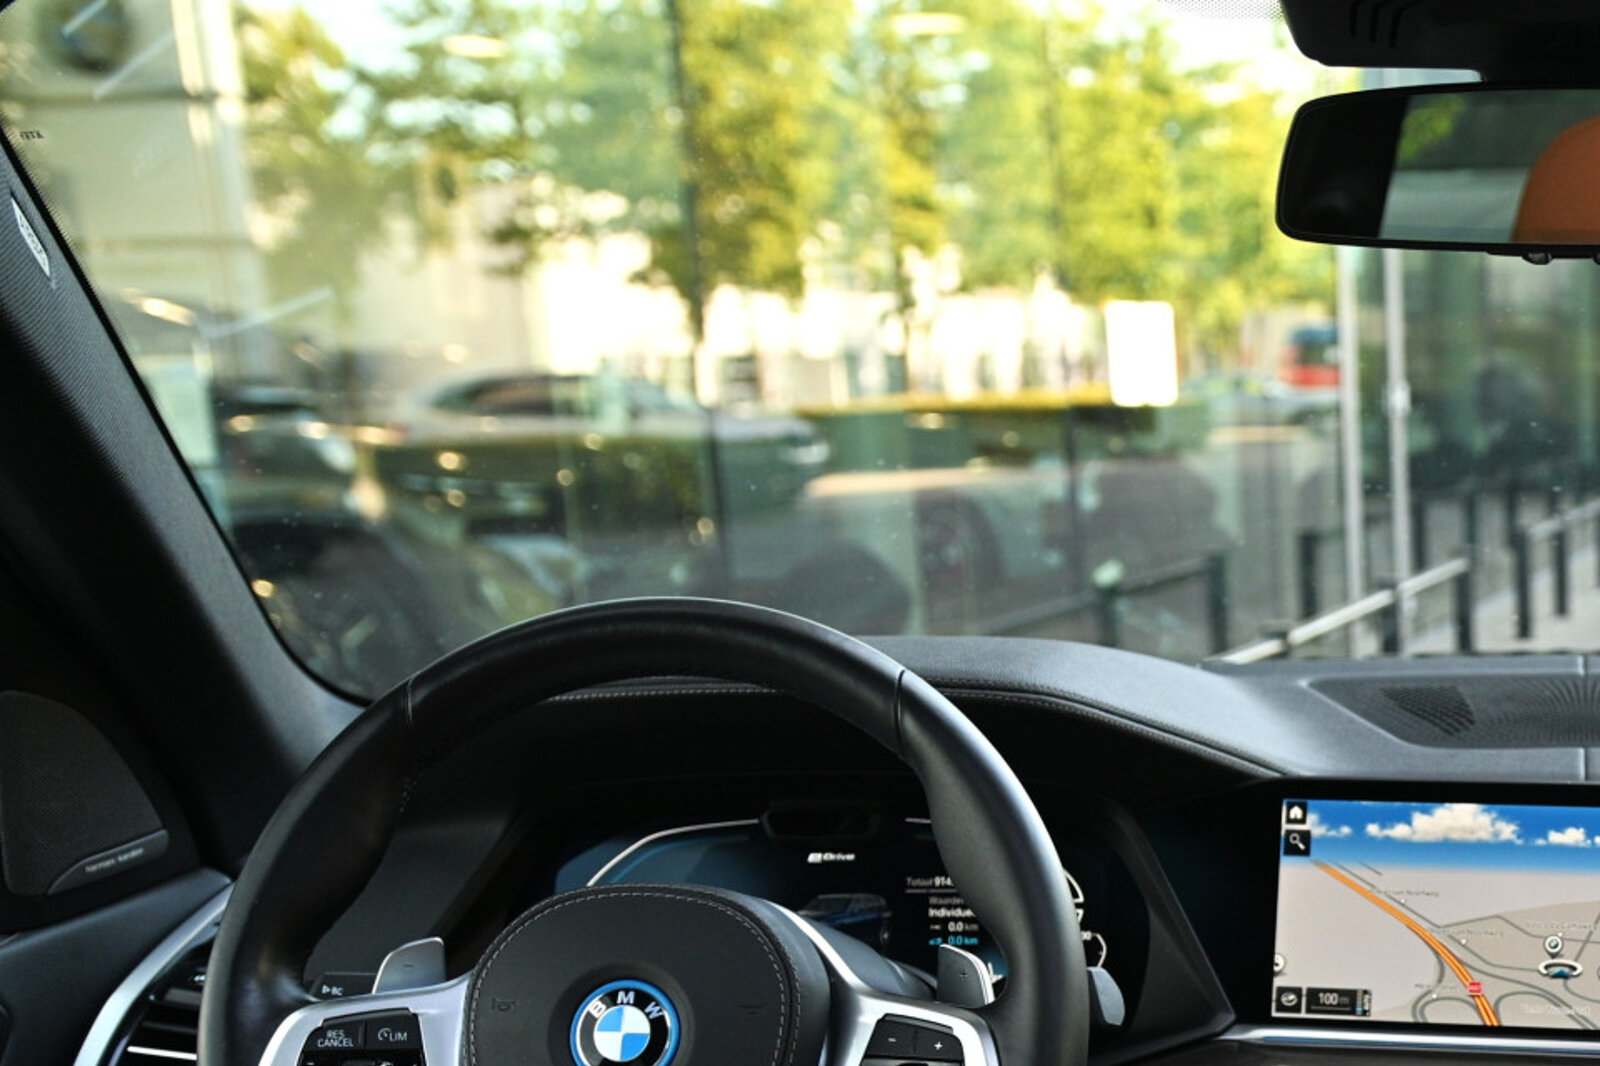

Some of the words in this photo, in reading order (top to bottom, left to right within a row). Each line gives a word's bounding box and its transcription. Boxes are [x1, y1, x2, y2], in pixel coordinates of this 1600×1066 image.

[947, 921, 963, 932] 0.0
[947, 935, 963, 945] 0.0
[964, 935, 980, 945] km
[1317, 991, 1338, 1005] 100
[588, 990, 665, 1020] BMW
[389, 1031, 409, 1042] LIM
[317, 1037, 354, 1048] CANCEL
